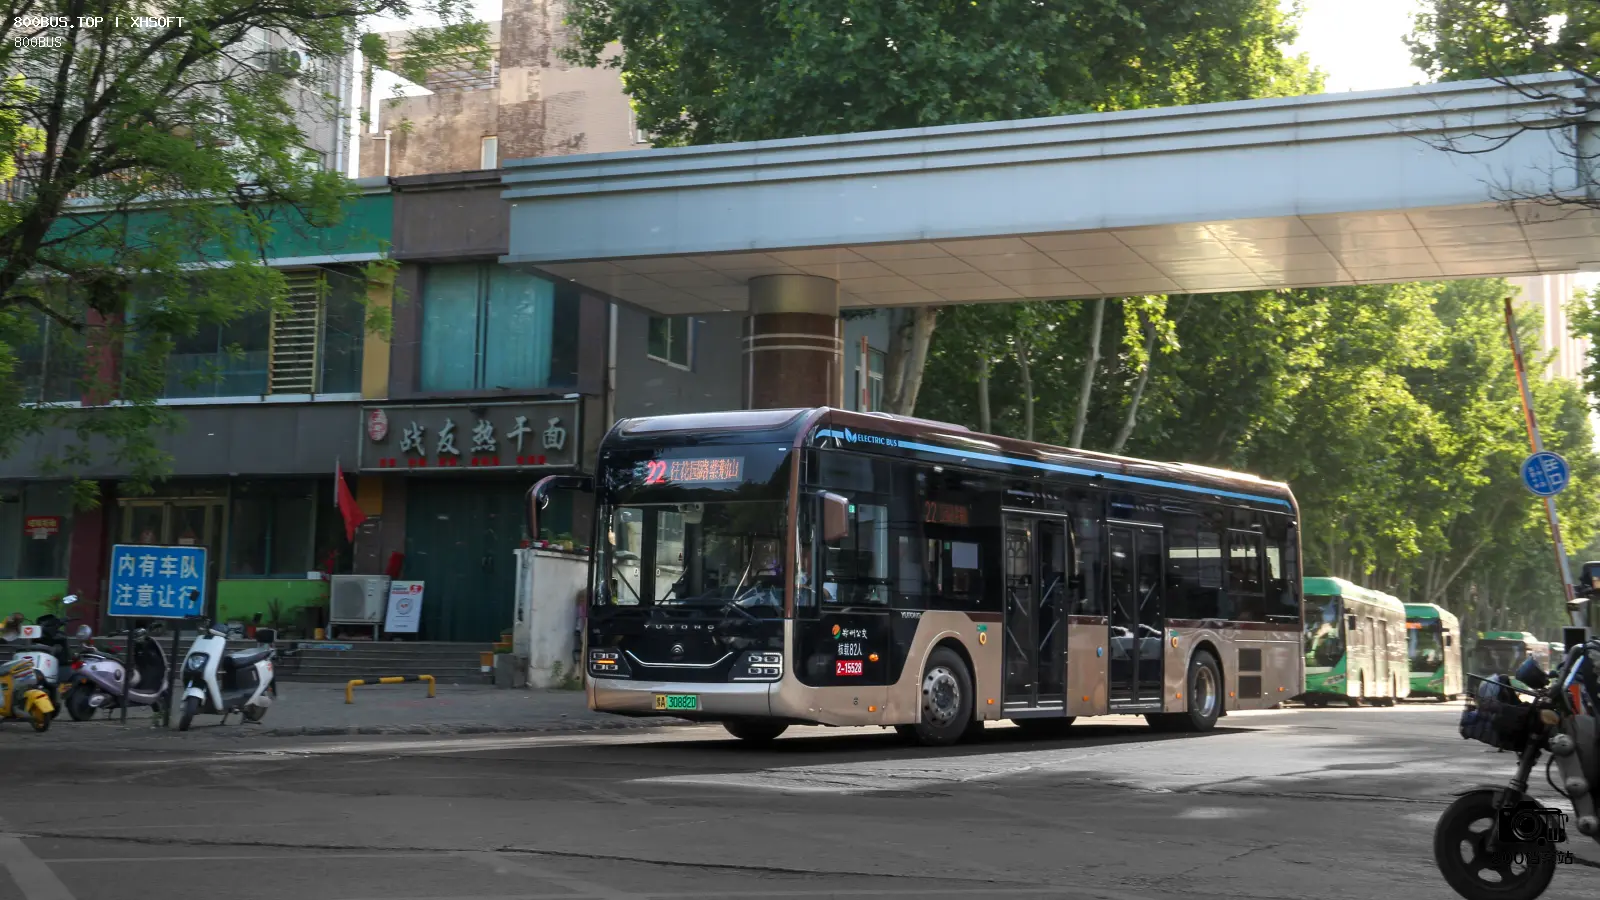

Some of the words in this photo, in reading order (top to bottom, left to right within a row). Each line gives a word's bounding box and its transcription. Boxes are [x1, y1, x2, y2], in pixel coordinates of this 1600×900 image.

[399, 415, 567, 456] 战友热干面
[857, 433, 885, 445] ELECTRIC
[886, 438, 897, 447] BUS
[645, 460, 668, 483] 22
[925, 500, 937, 523] 22
[117, 553, 199, 579] 内有车队
[115, 583, 198, 609] 注意让行
[837, 643, 863, 656] 核载82人
[837, 662, 862, 674] 2-15528
